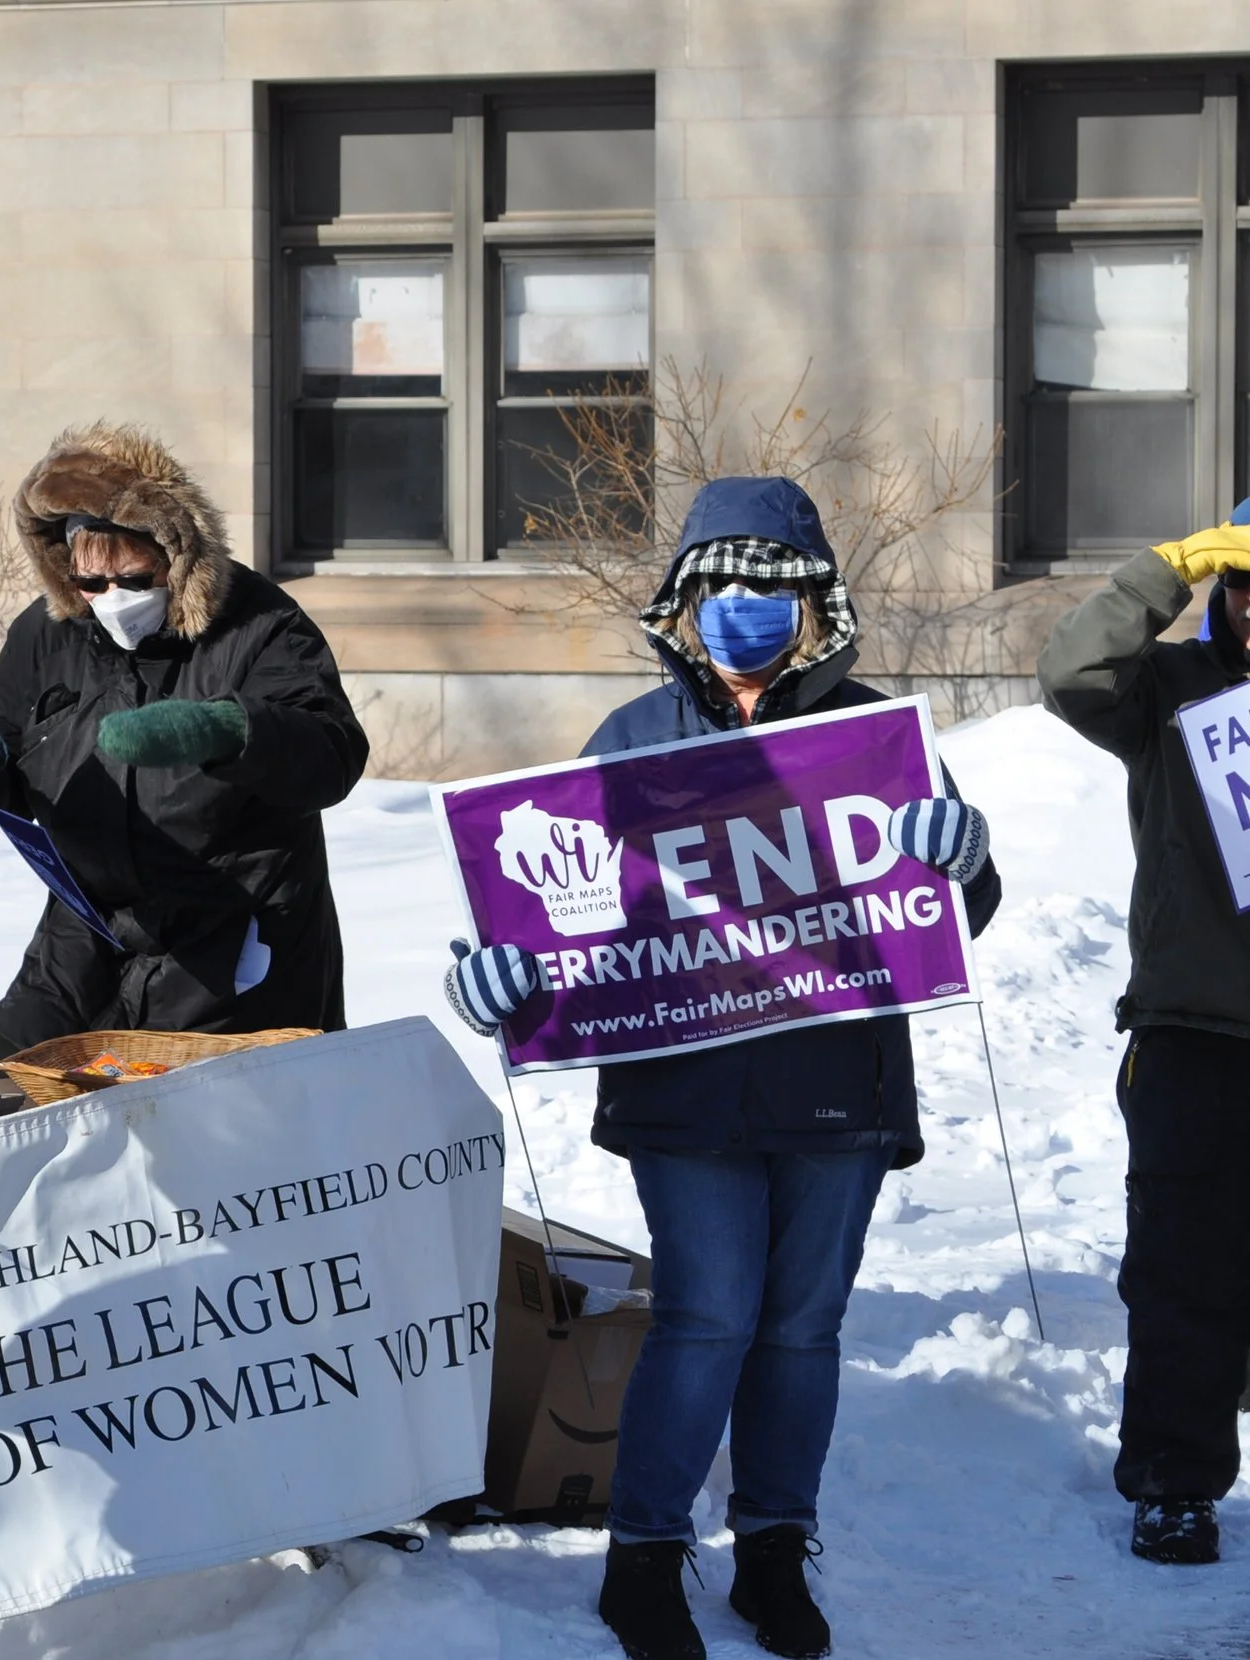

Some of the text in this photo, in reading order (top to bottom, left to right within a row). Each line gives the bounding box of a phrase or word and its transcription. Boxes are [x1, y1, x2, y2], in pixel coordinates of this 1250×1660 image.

[1202, 716, 1250, 763] FA
[653, 795, 902, 920] END
[548, 886, 613, 903] FAIR MAPS
[551, 900, 618, 917] COALITION
[534, 887, 943, 992] ERRYMANDERING
[571, 967, 892, 1036] www.FairMapsWI.com
[682, 1012, 788, 1041] Paid for by Fair Elections Project
[397, 1131, 505, 1191] COUNTY
[94, 1252, 372, 1371] LEAGUE
[71, 1344, 360, 1455] WOMEN
